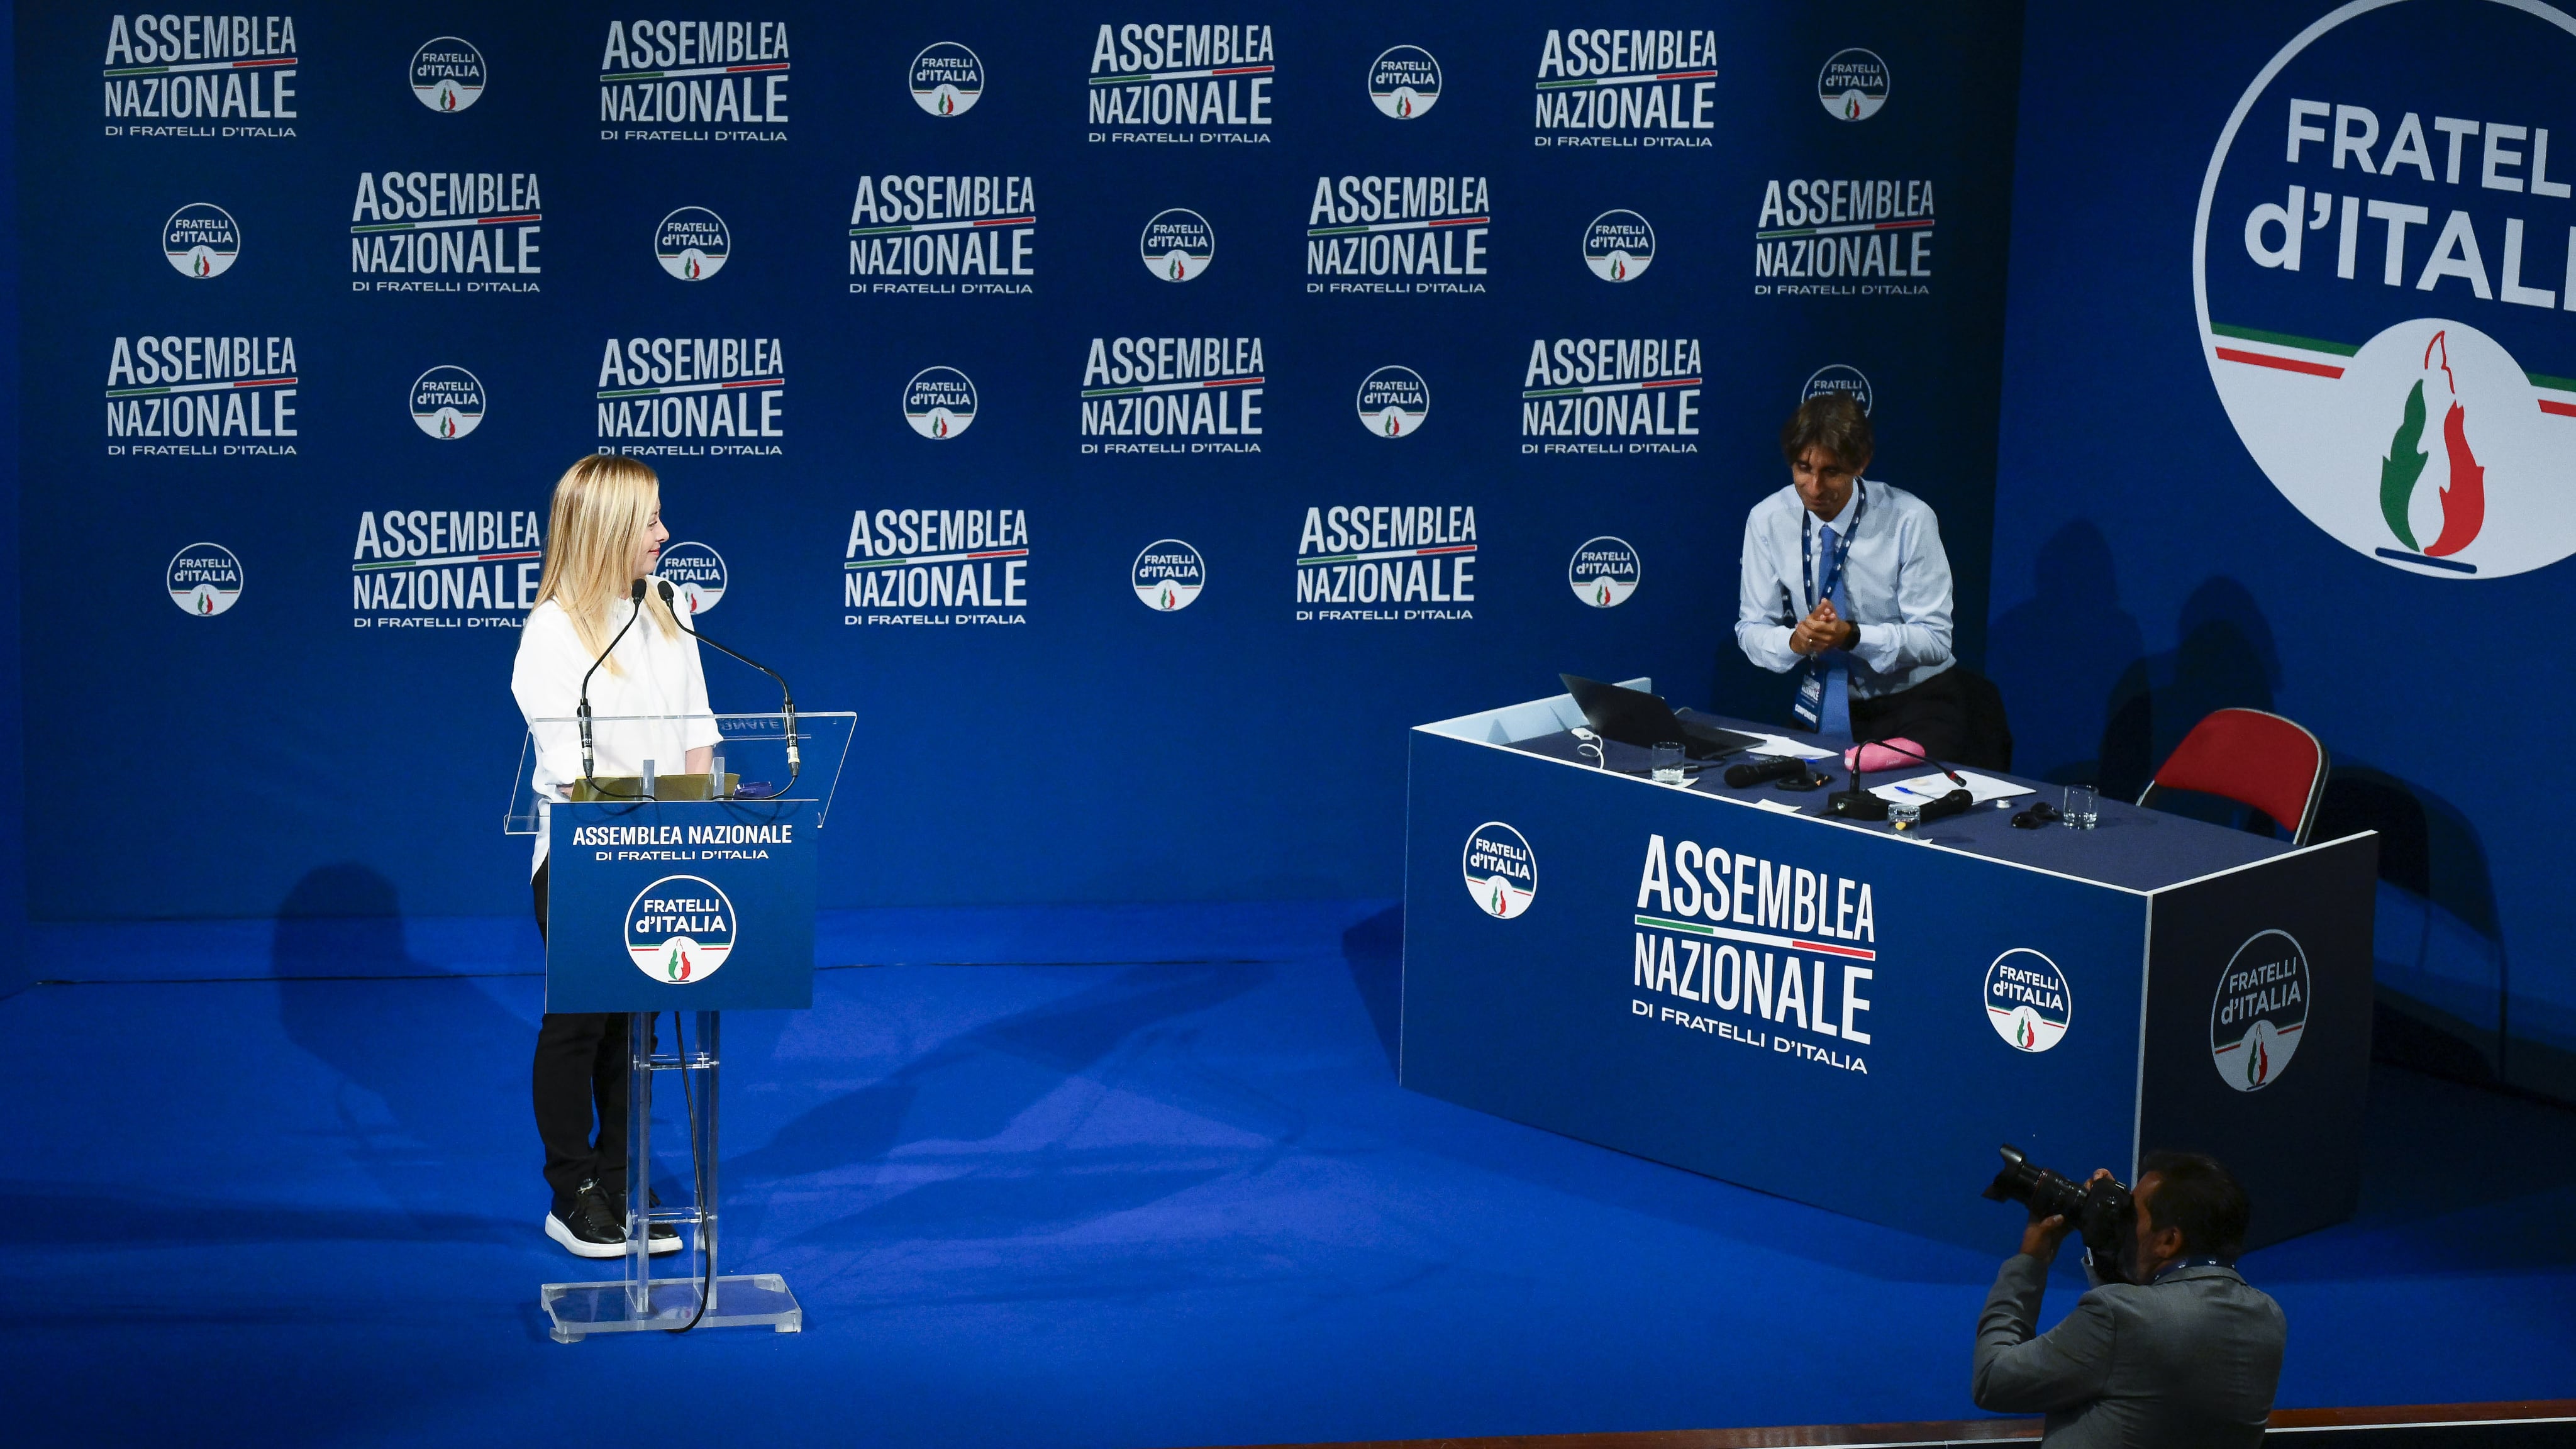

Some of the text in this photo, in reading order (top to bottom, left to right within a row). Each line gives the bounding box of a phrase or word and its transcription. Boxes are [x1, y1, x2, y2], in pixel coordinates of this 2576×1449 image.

[106, 14, 296, 65] ASSEMBLEA
[602, 20, 789, 70] ASSEMBLEA
[1091, 24, 1274, 73] ASSEMBLEA
[1538, 29, 1716, 78] ASSEMBLEA
[423, 53, 474, 62] FRATELLI
[922, 58, 972, 67] FRATELLI
[418, 65, 479, 77] d'ITALIA
[1381, 61, 1431, 70] FRATELLI
[1831, 64, 1879, 73] FRATELLI
[917, 69, 977, 81] d'ITALIA
[1376, 72, 1435, 84] d'ITALIA
[1826, 75, 1883, 86] d'ITALIA
[106, 70, 297, 118] NAZIONALE
[601, 75, 788, 122] NAZIONALE
[1089, 77, 1272, 125] NAZIONALE
[1536, 82, 1716, 129] NAZIONALE
[106, 126, 296, 136] DI FRATELLI D'ITALIA
[601, 131, 787, 141] DI FRATELLI D'ITALIA
[1089, 133, 1270, 143] DI FRATELLI D'ITALIA
[1535, 137, 1712, 147] DI FRATELLI D'ITALIA
[352, 172, 540, 221] ASSEMBLEA
[851, 175, 1035, 225] ASSEMBLEA
[1309, 176, 1489, 225] ASSEMBLEA
[1758, 179, 1933, 228] ASSEMBLEA
[176, 219, 228, 228] FRATELLI
[668, 223, 718, 232] FRATELLI
[1153, 225, 1203, 233] FRATELLI
[1596, 225, 1644, 235] FRATELLI
[170, 231, 233, 243] d'ITALIA
[662, 234, 723, 246] d'ITALIA
[1148, 236, 1208, 247] d'ITALIA
[1591, 236, 1648, 248] d'ITALIA
[352, 226, 540, 274] NAZIONALE
[850, 228, 1034, 275] NAZIONALE
[1307, 228, 1488, 275] NAZIONALE
[1756, 231, 1933, 277] NAZIONALE
[353, 282, 540, 292] DI FRATELLI D'ITALIA
[850, 284, 1032, 293] DI FRATELLI D'ITALIA
[1307, 284, 1485, 292] DI FRATELLI D'ITALIA
[1755, 286, 1929, 294] DI FRATELLI D'ITALIA
[108, 336, 296, 386] ASSEMBLEA
[599, 338, 783, 387] ASSEMBLEA
[1083, 337, 1263, 386] ASSEMBLEA
[1525, 339, 1701, 387] ASSEMBLEA
[423, 382, 474, 391] FRATELLI
[916, 382, 966, 391] FRATELLI
[1370, 382, 1418, 390] FRATELLI
[1814, 380, 1862, 389] FRATELLI
[418, 393, 479, 404] d'ITALIA
[911, 393, 970, 404] d'ITALIA
[1364, 392, 1423, 404] d'ITALIA
[108, 389, 297, 437] NAZIONALE
[599, 390, 783, 438] NAZIONALE
[1082, 389, 1263, 436] NAZIONALE
[1523, 389, 1700, 436] NAZIONALE
[108, 446, 296, 455] DI FRATELLI D'ITALIA
[599, 446, 782, 455] DI FRATELLI D'ITALIA
[1082, 443, 1260, 453] DI FRATELLI D'ITALIA
[1522, 444, 1697, 453] DI FRATELLI D'ITALIA
[354, 511, 540, 560] ASSEMBLEA
[847, 509, 1028, 558] ASSEMBLEA
[1299, 506, 1476, 554] ASSEMBLEA
[665, 558, 716, 567] FRATELLI
[1145, 555, 1194, 564] FRATELLI
[1582, 552, 1629, 561] FRATELLI
[180, 559, 231, 567] FRATELLI
[1577, 563, 1634, 574] d'ITALIA
[174, 570, 236, 581] d'ITALIA
[1140, 566, 1198, 577] d'ITALIA
[845, 560, 1027, 607] NAZIONALE
[1297, 556, 1475, 602] NAZIONALE
[354, 563, 540, 609] NAZIONALE
[845, 615, 1026, 625] DI FRATELLI D'ITALIA
[1297, 610, 1472, 620] DI FRATELLI D'ITALIA
[354, 618, 370, 627] DI
[378, 618, 460, 627] FRATELLI
[573, 825, 792, 845] ASSEMBLEA NAZIONALE
[596, 850, 769, 860] DI FRATELLI D'ITALIA
[1476, 838, 1526, 861] FRATELLI
[1470, 853, 1531, 880] d'ITALIA
[1637, 834, 1874, 942] ASSEMBLEA
[644, 899, 719, 913] FRATELLI
[636, 916, 726, 933] d'ITALIA
[2000, 965, 2058, 991] FRATELLI
[2229, 957, 2296, 993] FRATELLI
[1635, 933, 1872, 1045] NAZIONALE
[1993, 980, 2063, 1011] d'ITALIA
[2221, 980, 2301, 1024] d'ITALIA
[1633, 999, 1867, 1074] DI FRATELLI D'ITALIA
